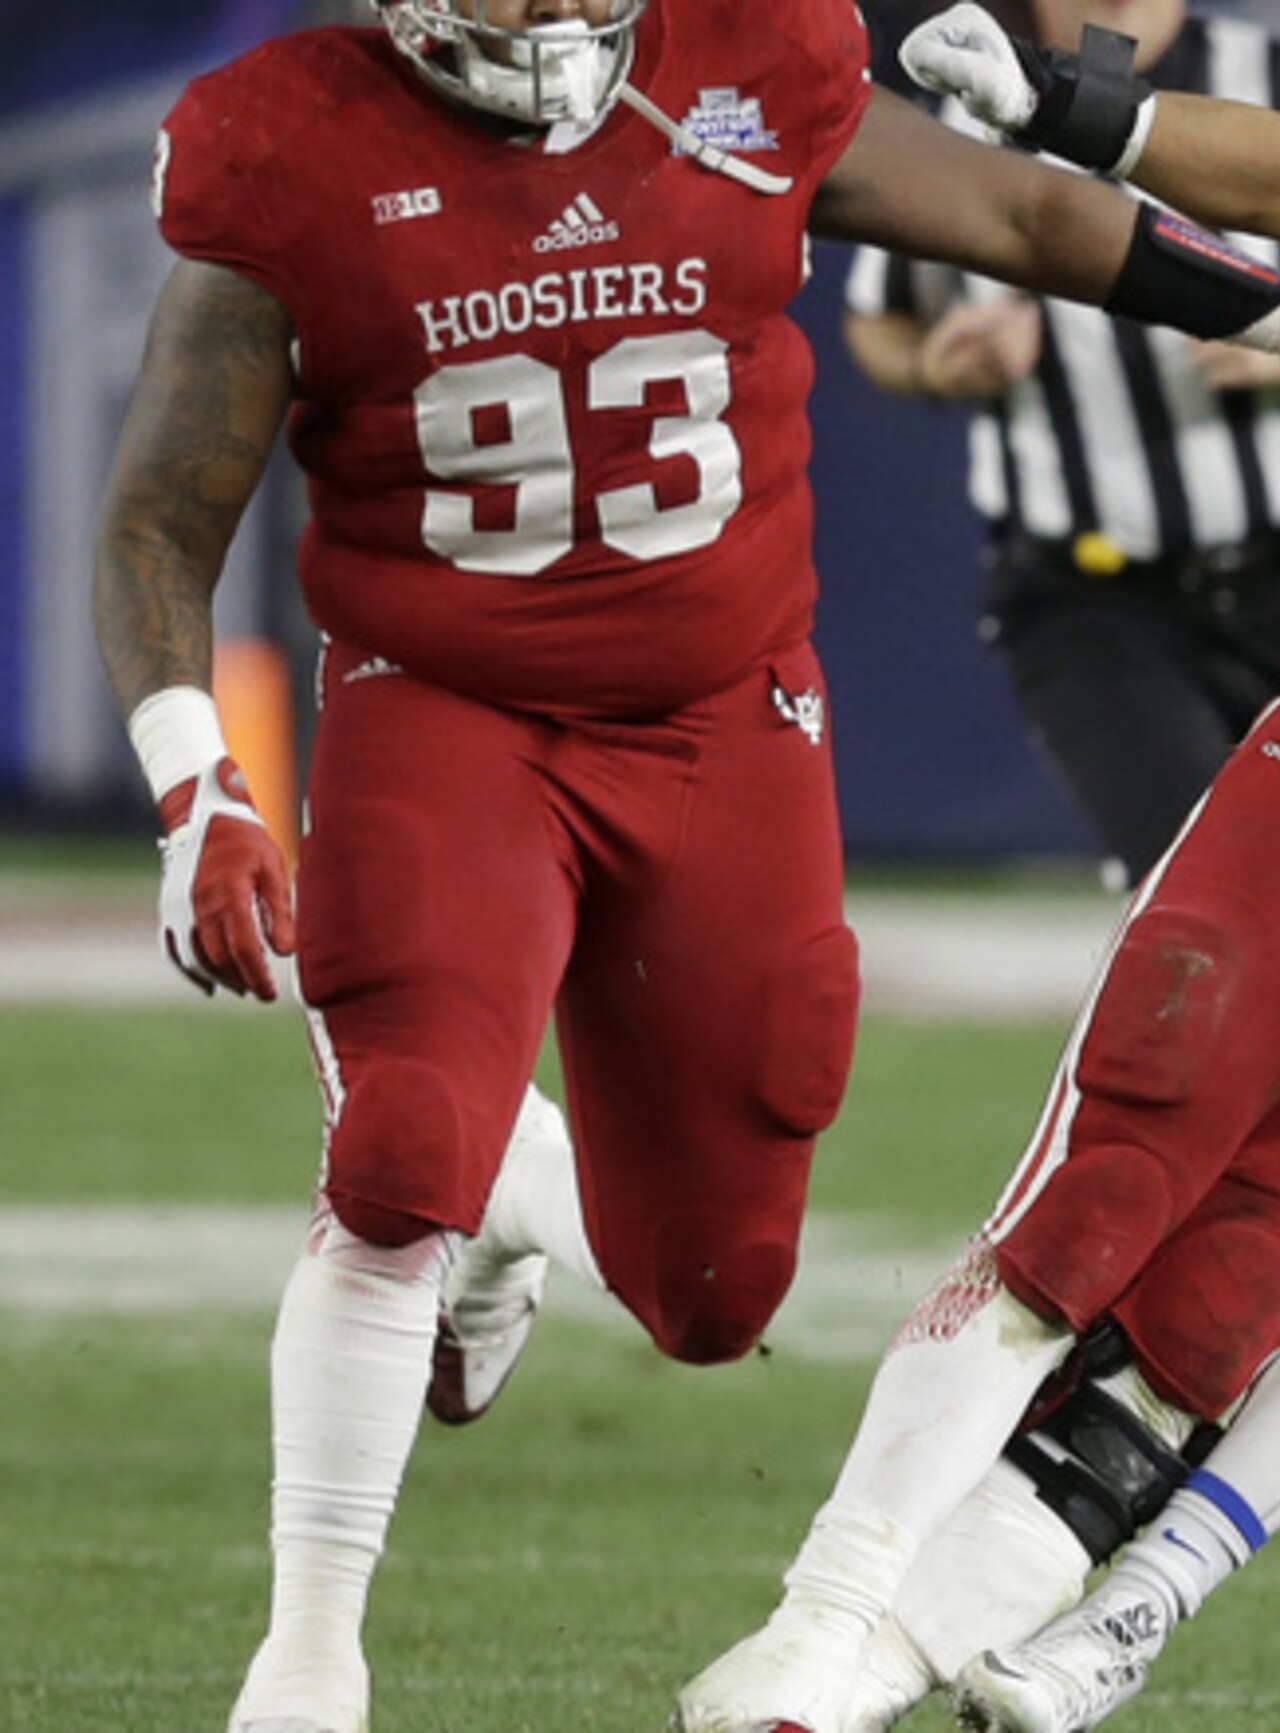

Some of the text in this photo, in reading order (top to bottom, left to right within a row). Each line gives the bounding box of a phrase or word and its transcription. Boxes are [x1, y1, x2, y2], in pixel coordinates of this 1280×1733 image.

[533, 220, 620, 254] adidas
[416, 258, 708, 354] HOOSIERS
[413, 329, 742, 575] 93
